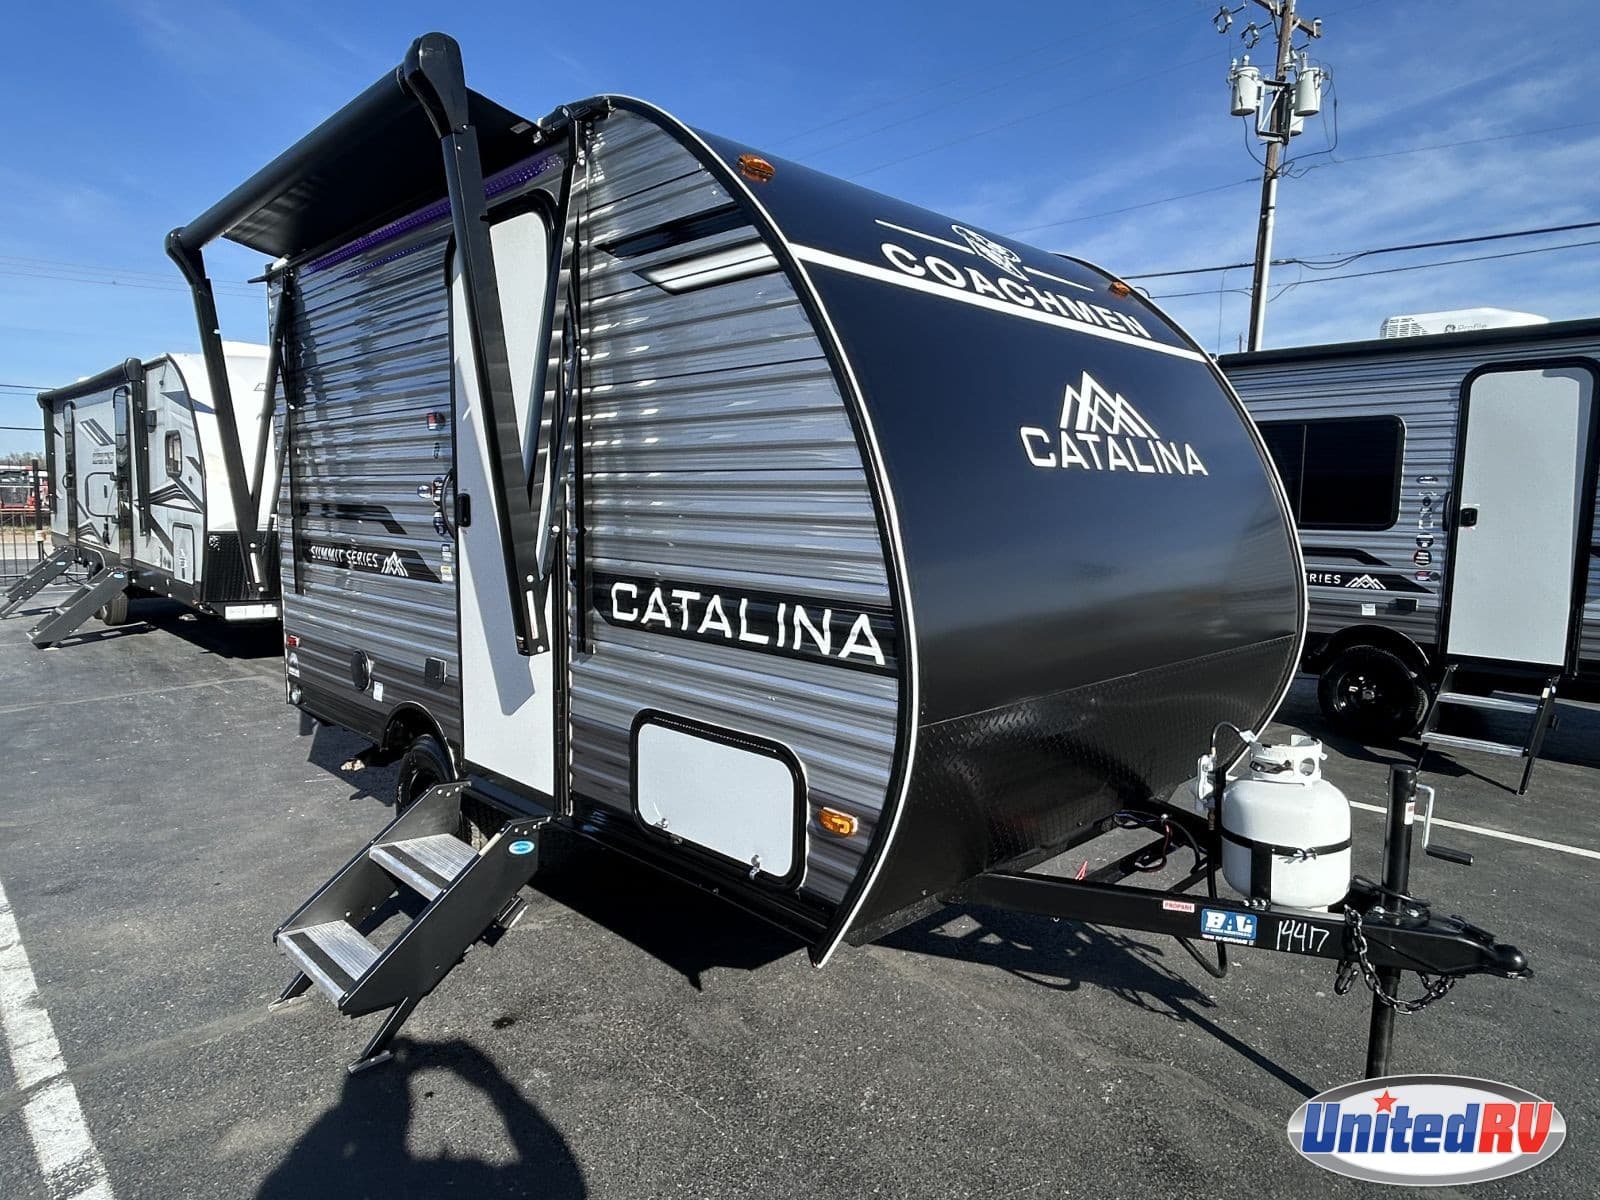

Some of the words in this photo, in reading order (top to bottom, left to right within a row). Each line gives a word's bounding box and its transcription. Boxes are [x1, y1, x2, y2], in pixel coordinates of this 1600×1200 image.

[881, 243, 1152, 338] COACHMEN
[1020, 426, 1209, 476] CATALINA
[310, 545, 344, 562] SUMMIT
[346, 550, 379, 568] SERIES
[611, 582, 886, 665] CATALINA
